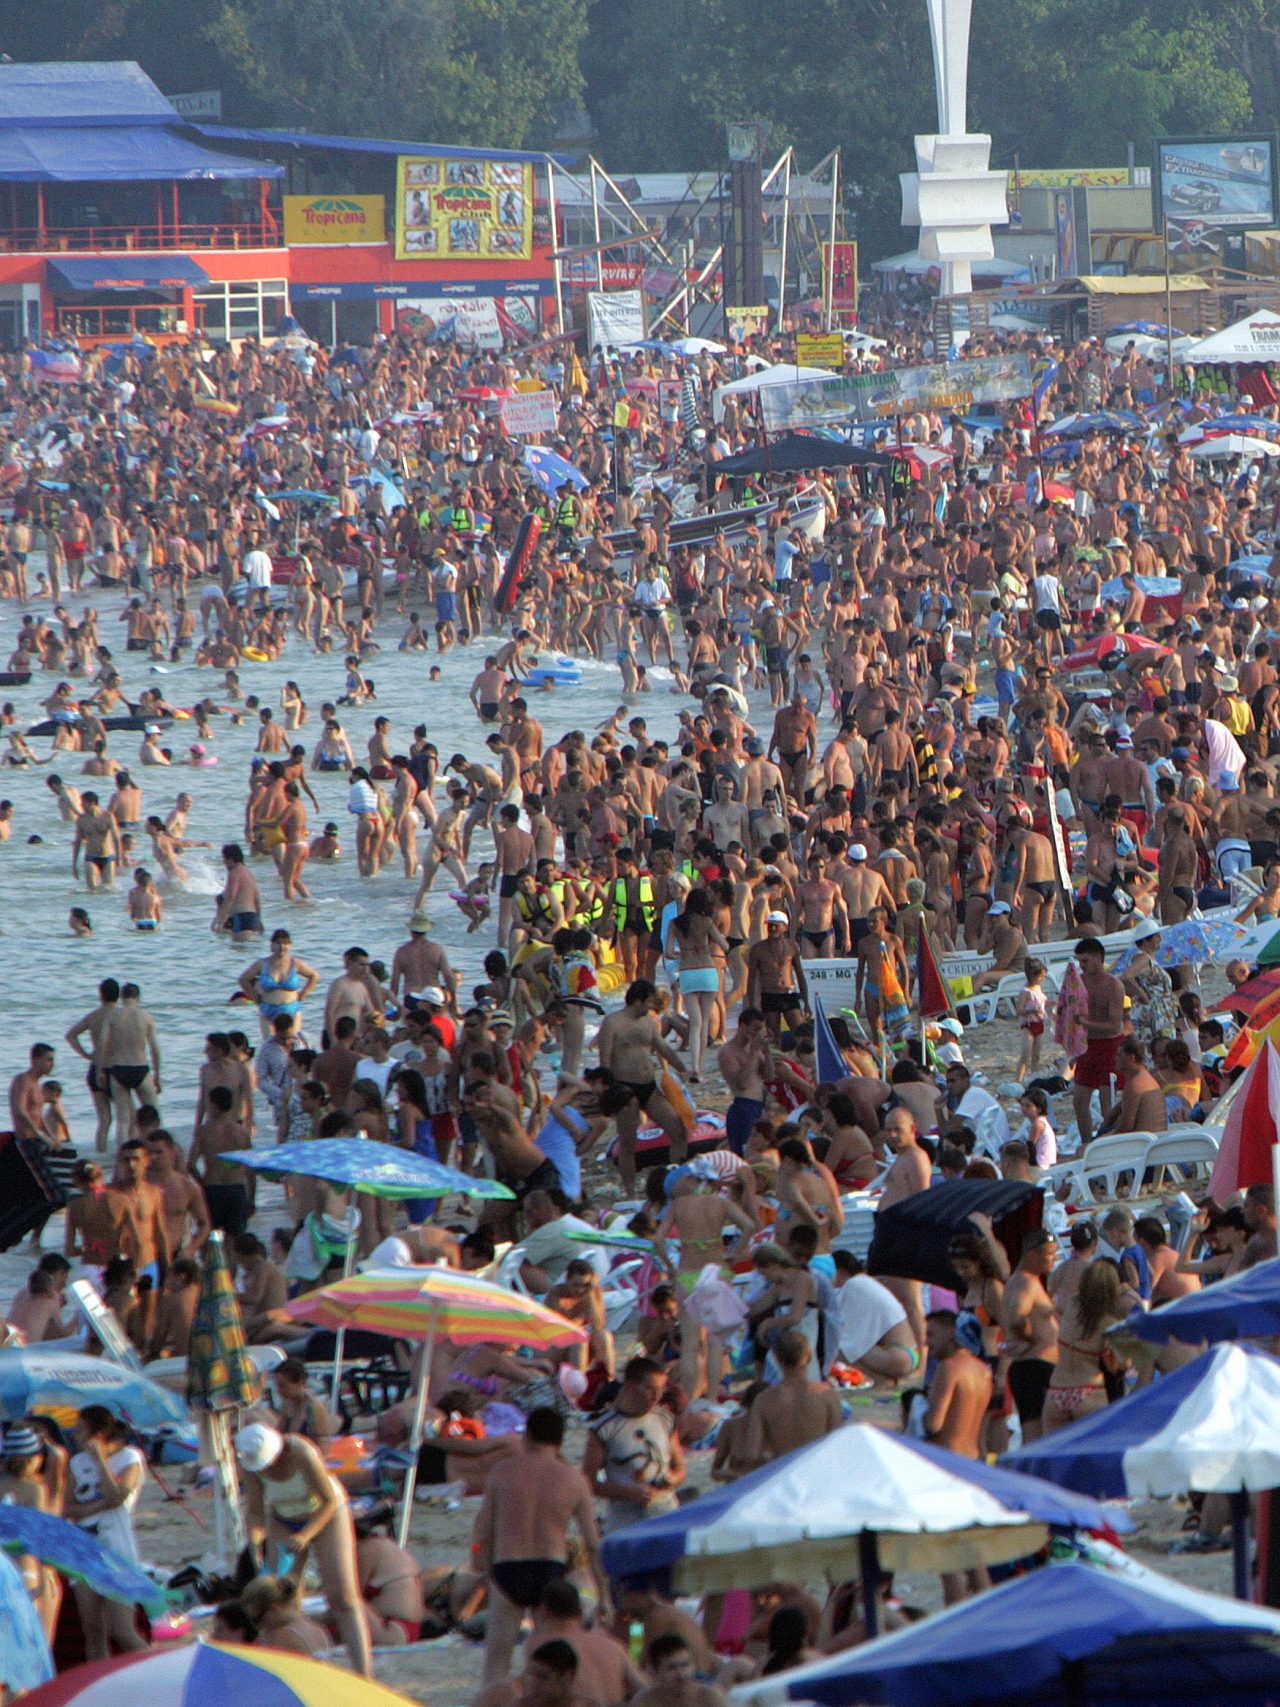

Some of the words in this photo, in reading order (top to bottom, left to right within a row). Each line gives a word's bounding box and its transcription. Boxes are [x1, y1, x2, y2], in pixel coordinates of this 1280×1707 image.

[302, 207, 367, 226] Tropicana
[851, 372, 898, 388] NAUTICA
[810, 970, 827, 980] 248
[947, 962, 981, 976] CREDO
